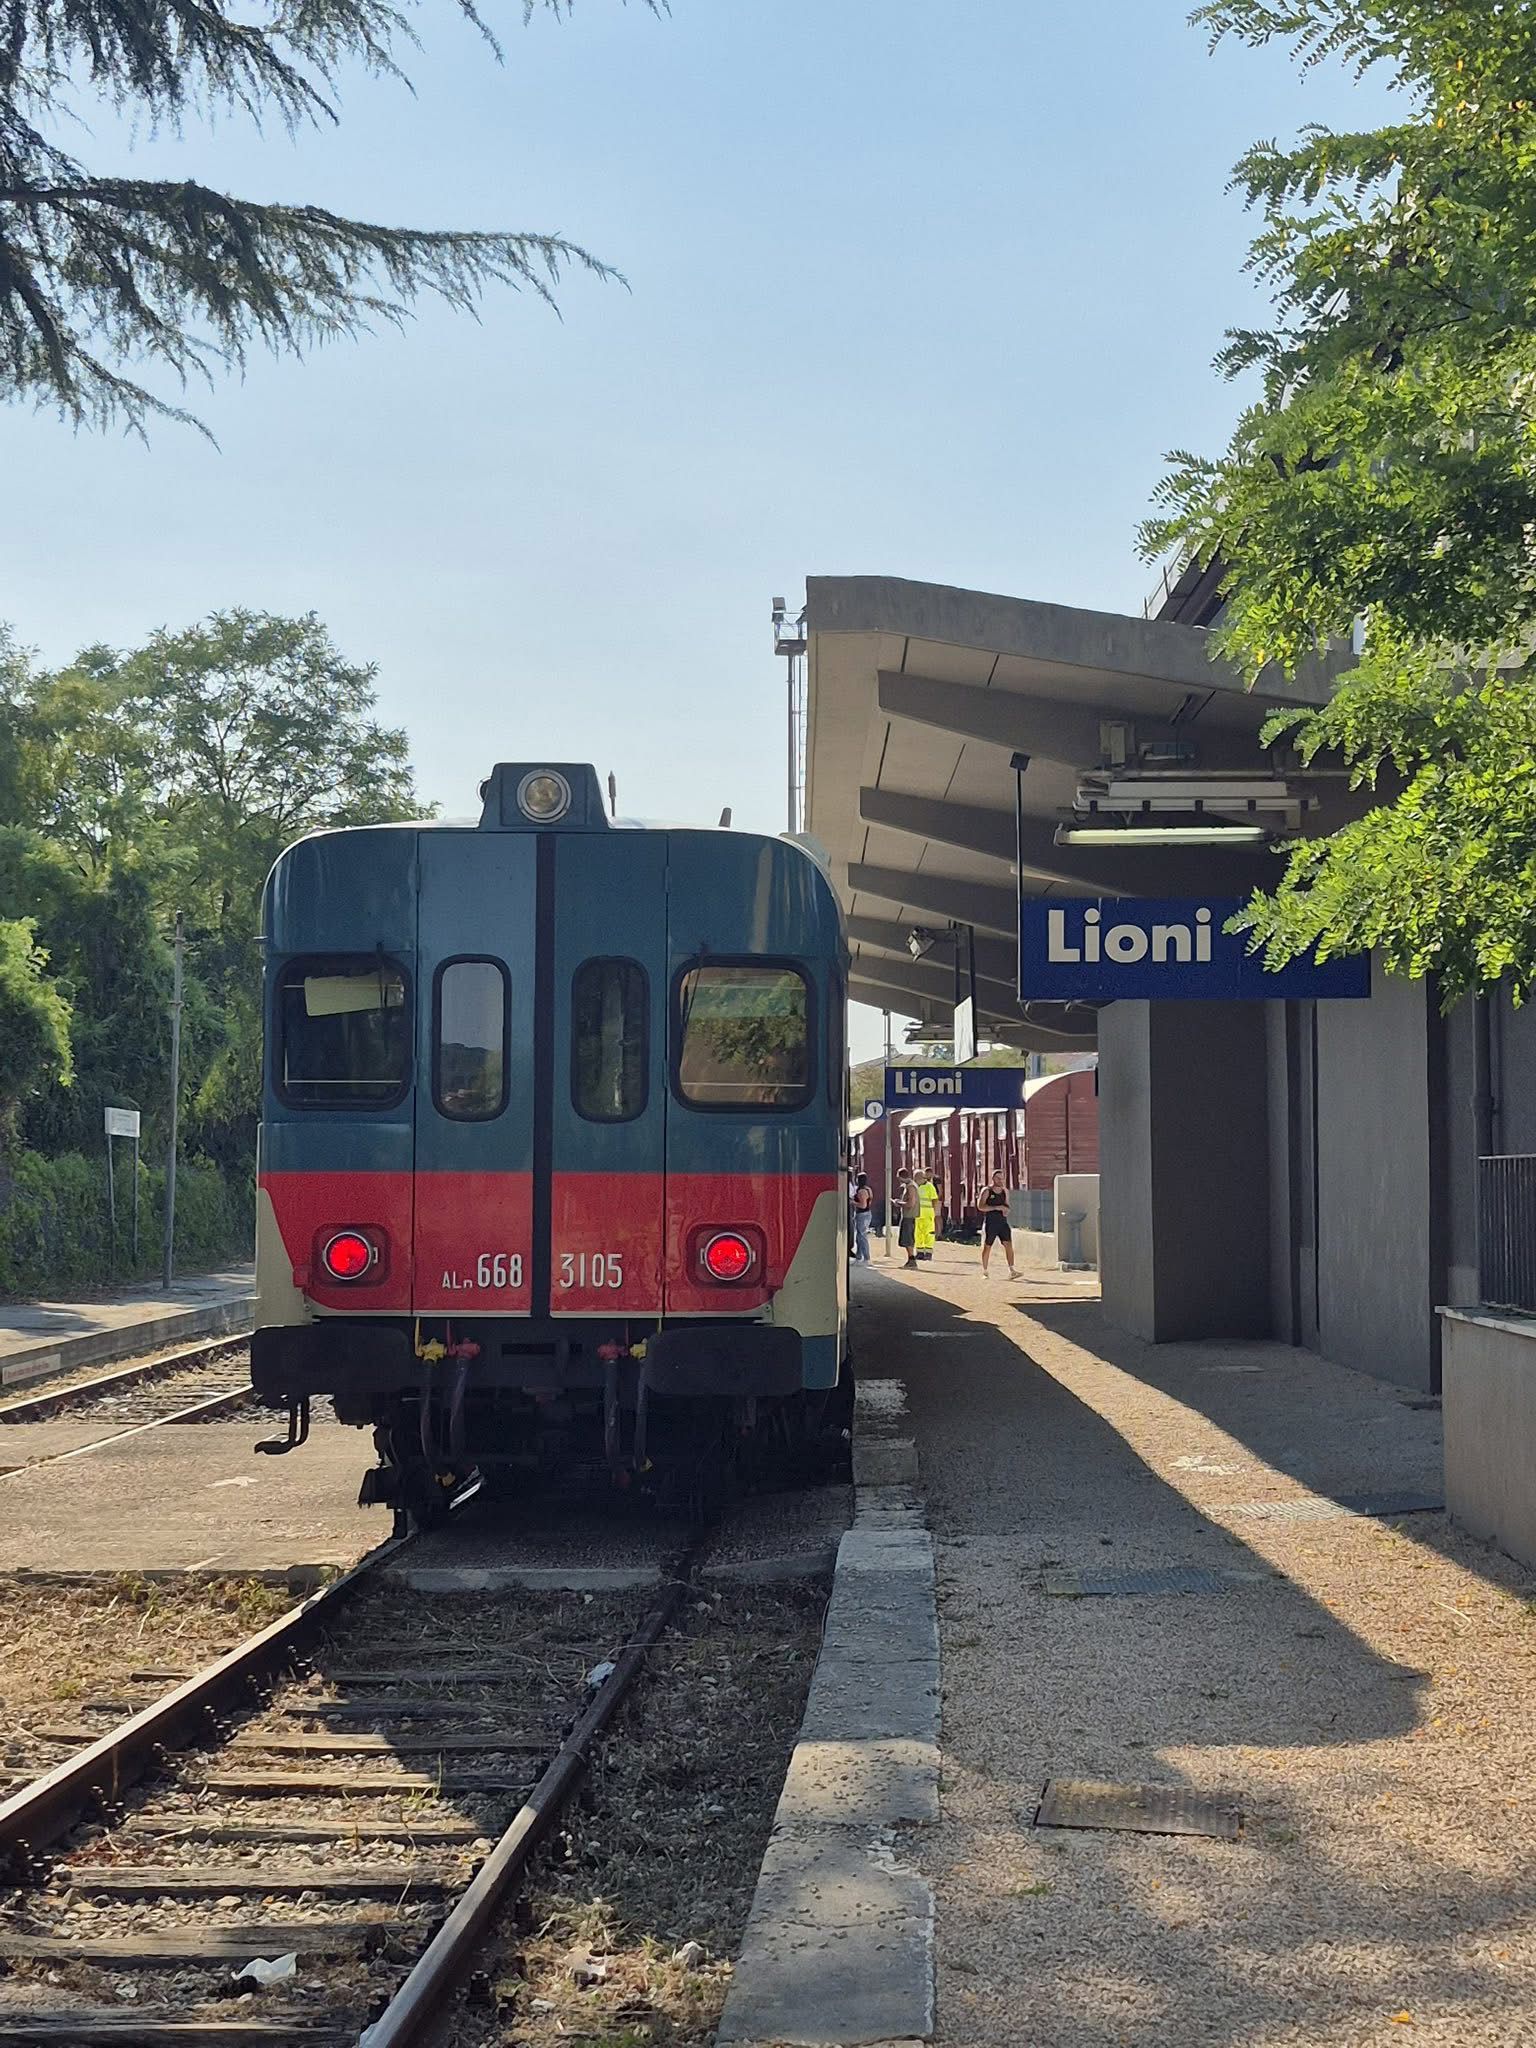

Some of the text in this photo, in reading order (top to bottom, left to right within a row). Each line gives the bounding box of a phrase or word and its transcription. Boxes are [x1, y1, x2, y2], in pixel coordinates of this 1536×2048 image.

[1048, 907, 1211, 963] Lioni
[895, 1071, 962, 1094] Lioni
[441, 1253, 622, 1289] ALn 668 3105
